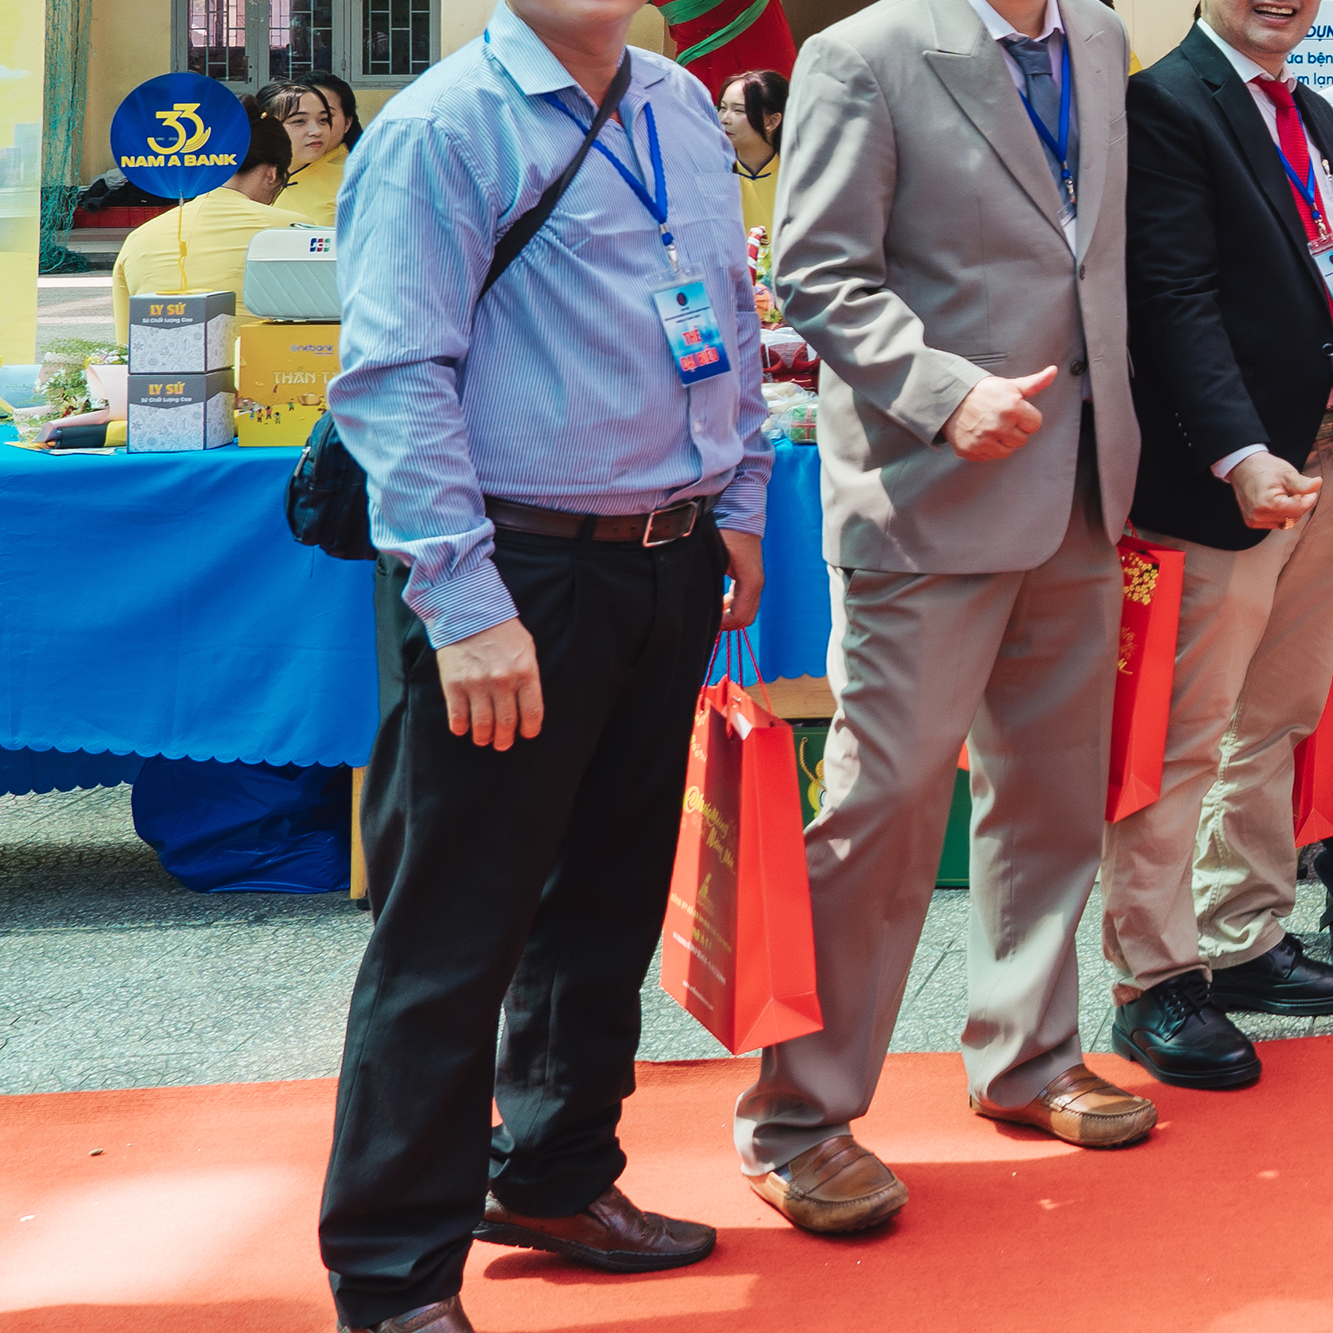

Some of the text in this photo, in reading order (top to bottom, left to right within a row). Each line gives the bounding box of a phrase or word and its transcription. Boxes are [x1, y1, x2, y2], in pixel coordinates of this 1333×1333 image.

[146, 103, 212, 155] 33
[121, 154, 237, 167] NAM A BANK
[309, 237, 331, 253] JCB
[150, 301, 187, 316] LY SỨ
[148, 381, 186, 395] LY SỨ
